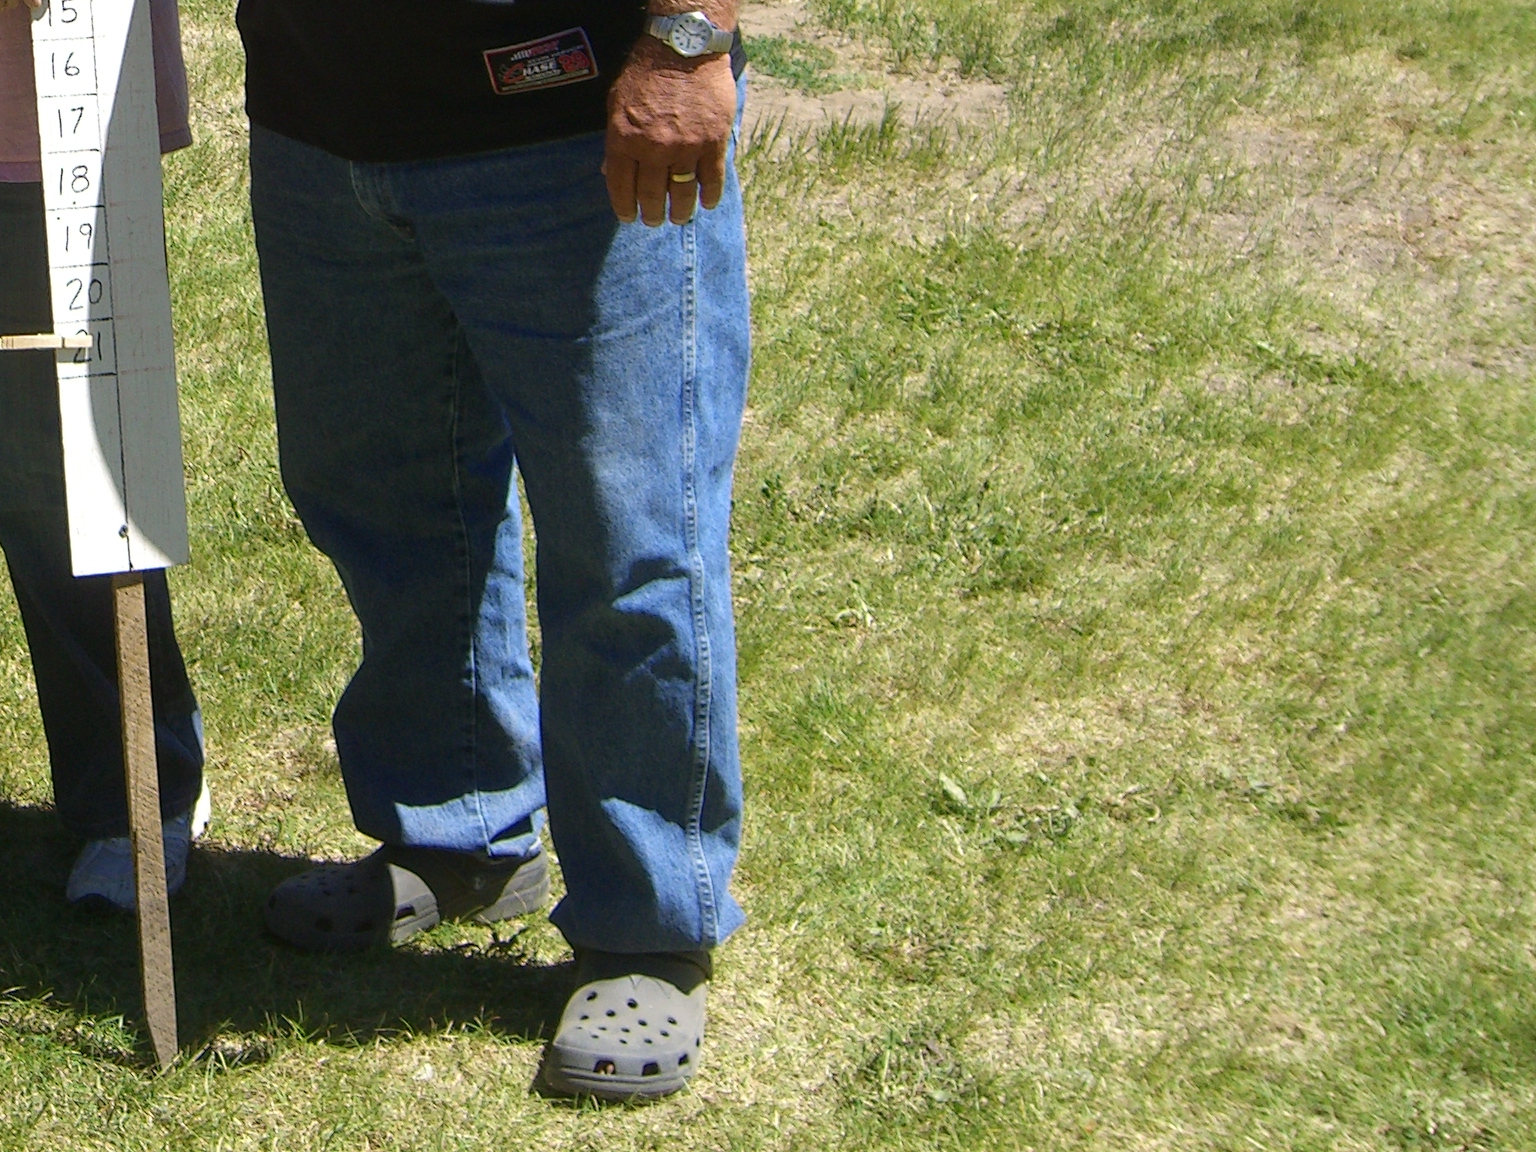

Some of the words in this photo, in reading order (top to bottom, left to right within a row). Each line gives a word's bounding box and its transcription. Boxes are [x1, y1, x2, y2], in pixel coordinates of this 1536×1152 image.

[50, 51, 81, 81] 16
[56, 106, 85, 139] 17
[59, 164, 91, 196] 18
[64, 222, 93, 253] 19
[65, 277, 104, 311] 20
